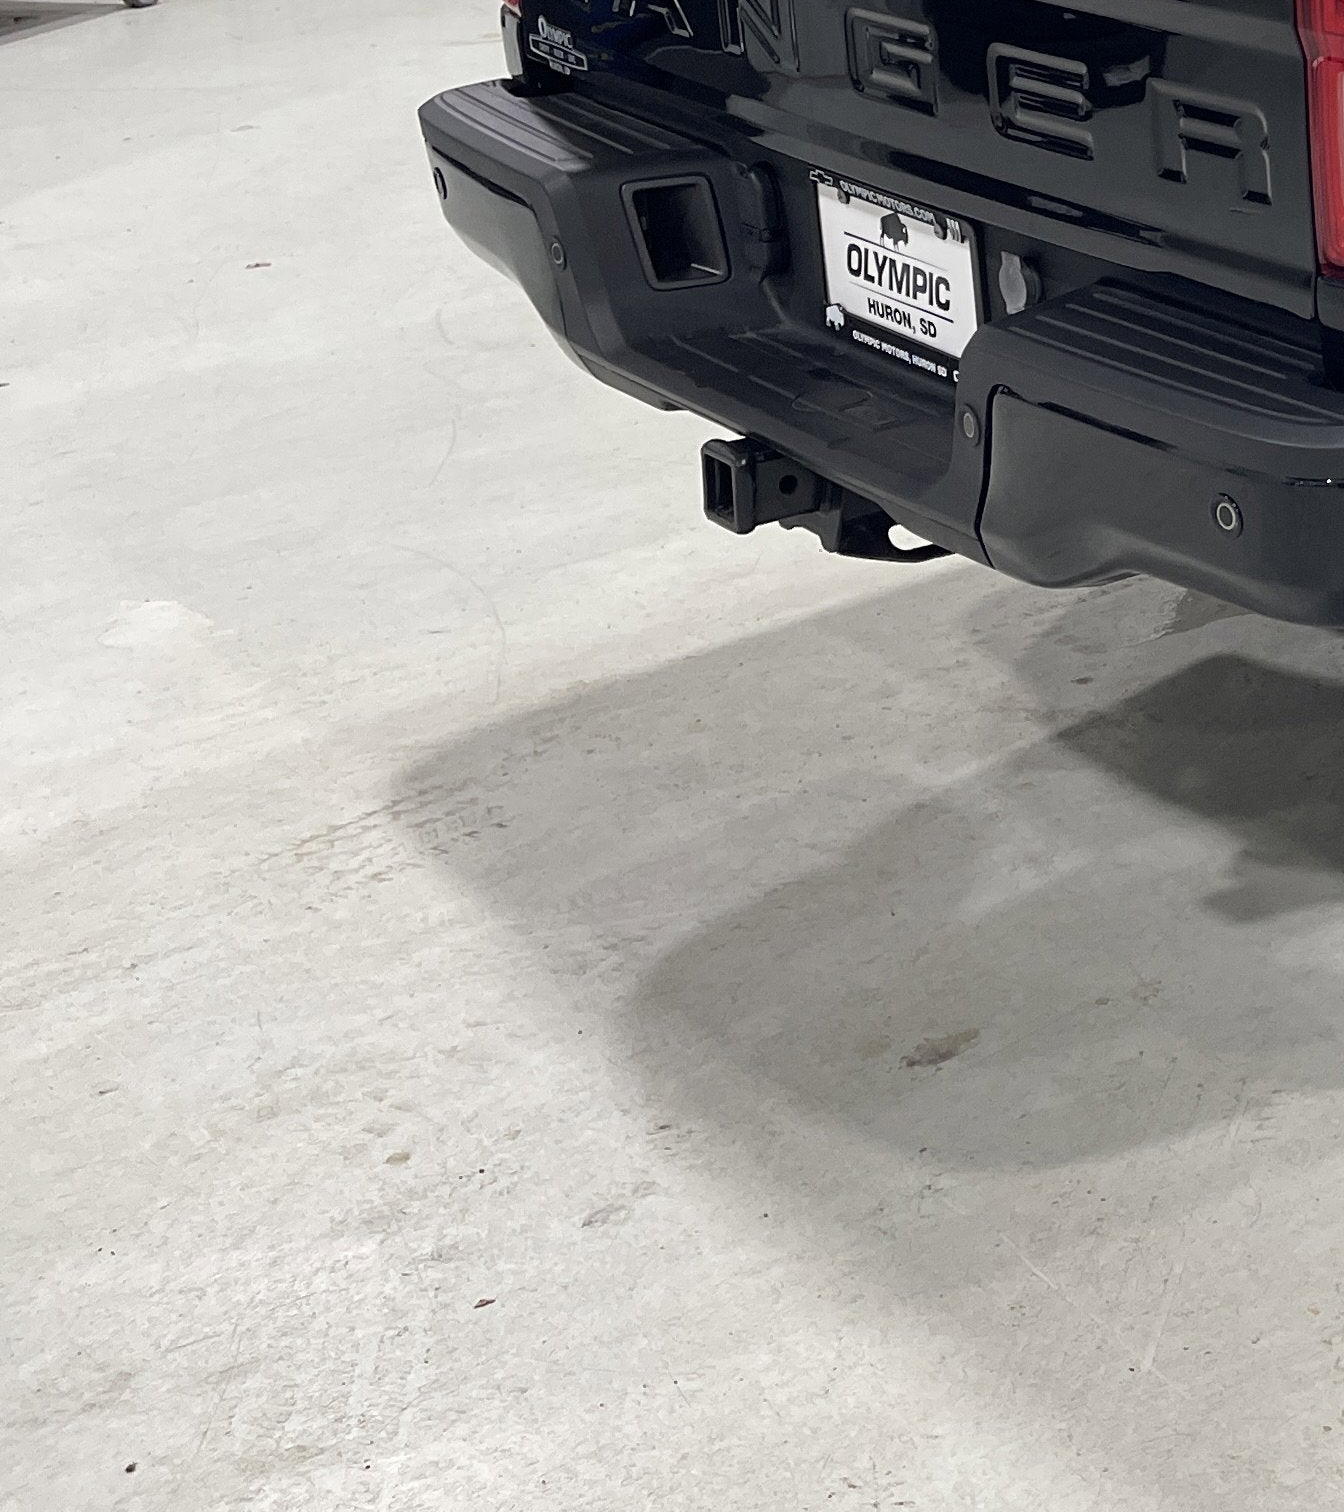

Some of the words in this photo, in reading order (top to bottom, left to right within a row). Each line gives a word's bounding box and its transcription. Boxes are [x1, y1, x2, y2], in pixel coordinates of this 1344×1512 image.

[846, 243, 950, 312] OLYMPIC
[867, 297, 916, 334] HURON,
[920, 318, 937, 338] SD
